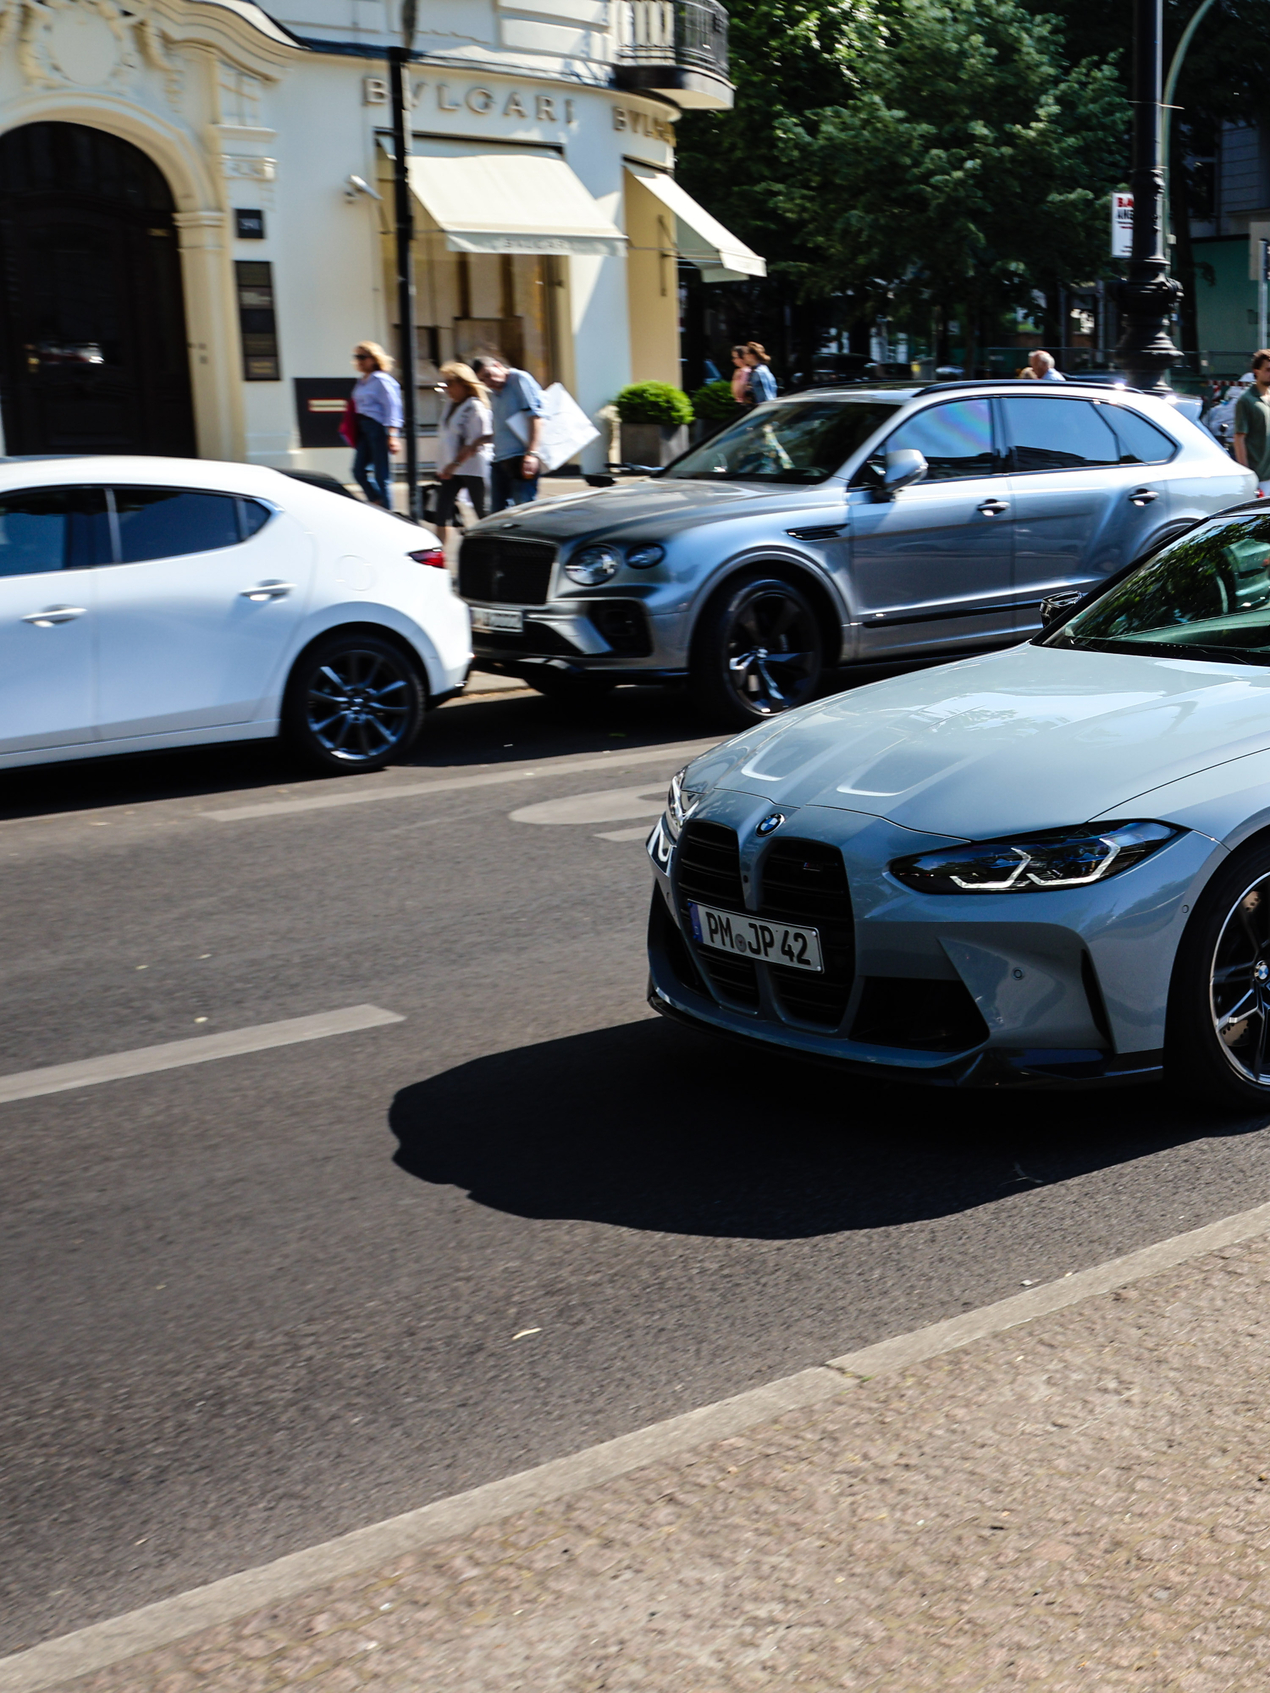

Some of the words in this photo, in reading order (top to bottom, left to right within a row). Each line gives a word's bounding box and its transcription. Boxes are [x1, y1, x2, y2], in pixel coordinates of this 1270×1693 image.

[362, 76, 575, 125] BVLGARI
[705, 911, 735, 949] PM
[747, 922, 775, 958] JP
[781, 929, 811, 966] 42
